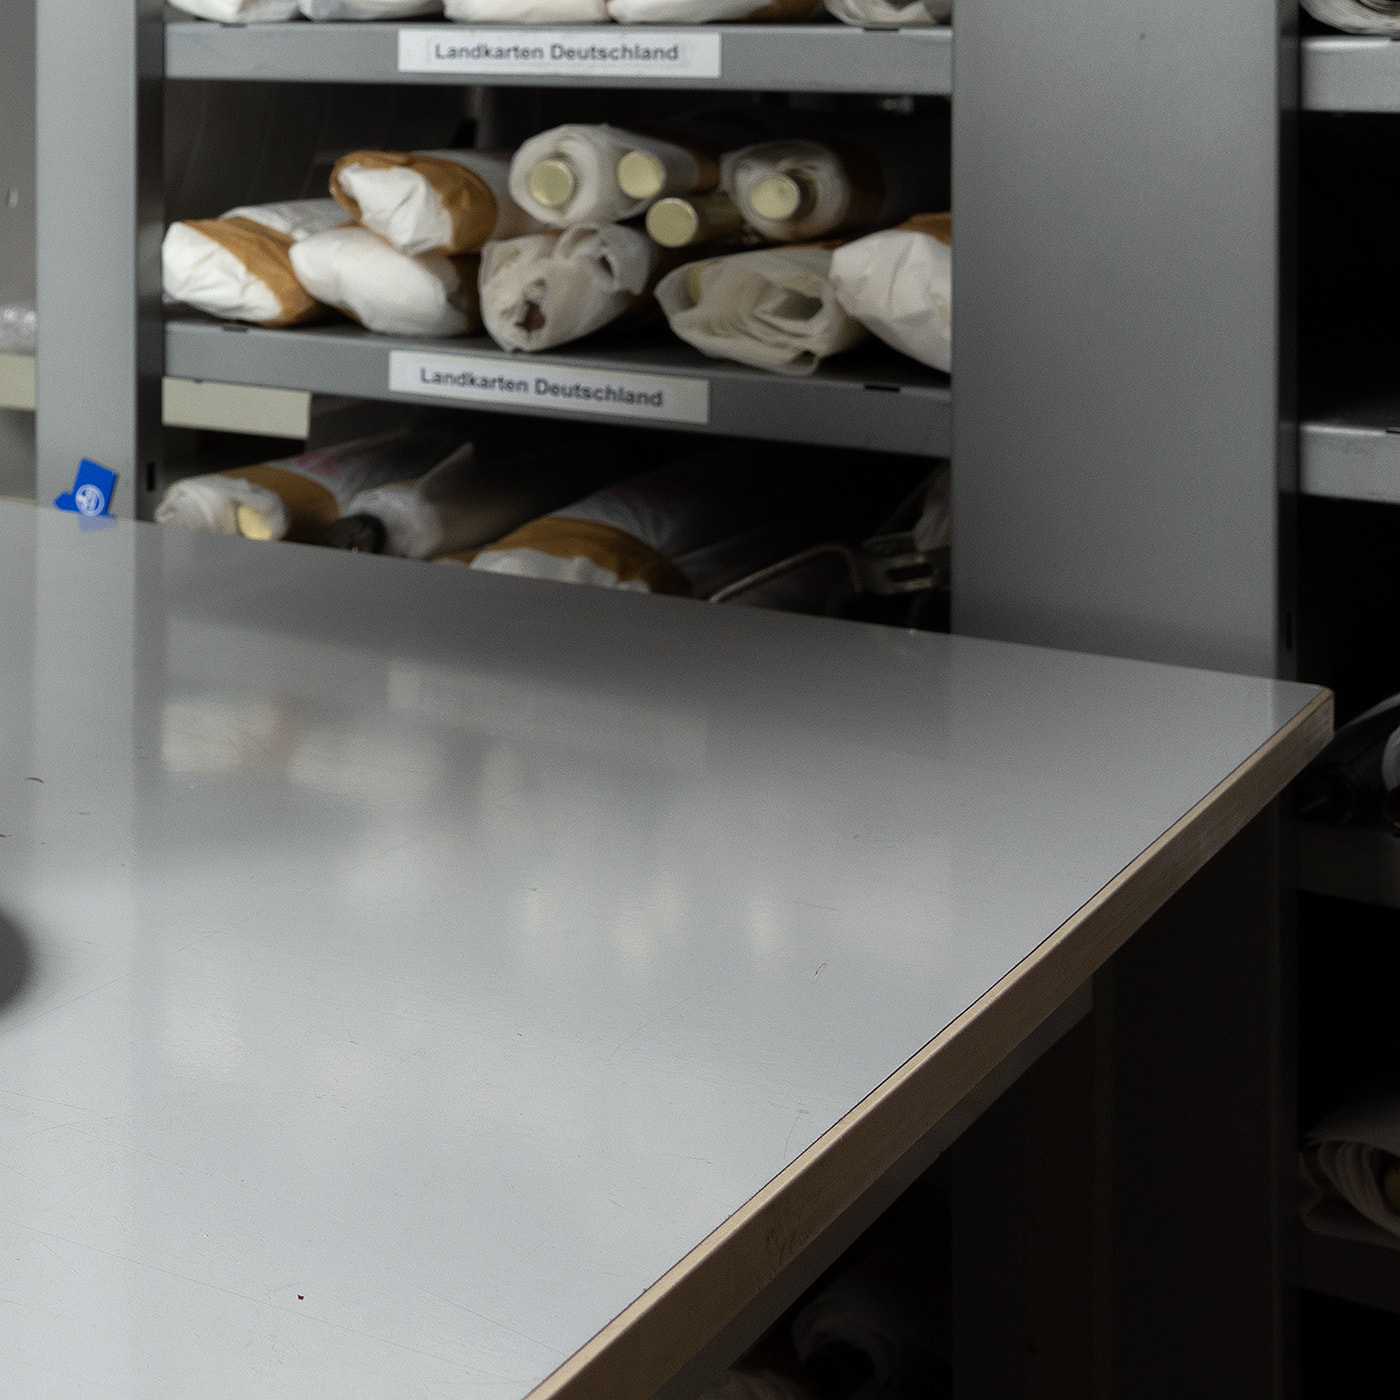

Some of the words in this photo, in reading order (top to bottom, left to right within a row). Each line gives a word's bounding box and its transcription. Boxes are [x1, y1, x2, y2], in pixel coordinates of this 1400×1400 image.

[434, 41, 545, 62] Landkarten
[549, 41, 680, 63] Deutschland
[419, 365, 529, 398] Landkarten
[532, 377, 663, 410] Deutschland
